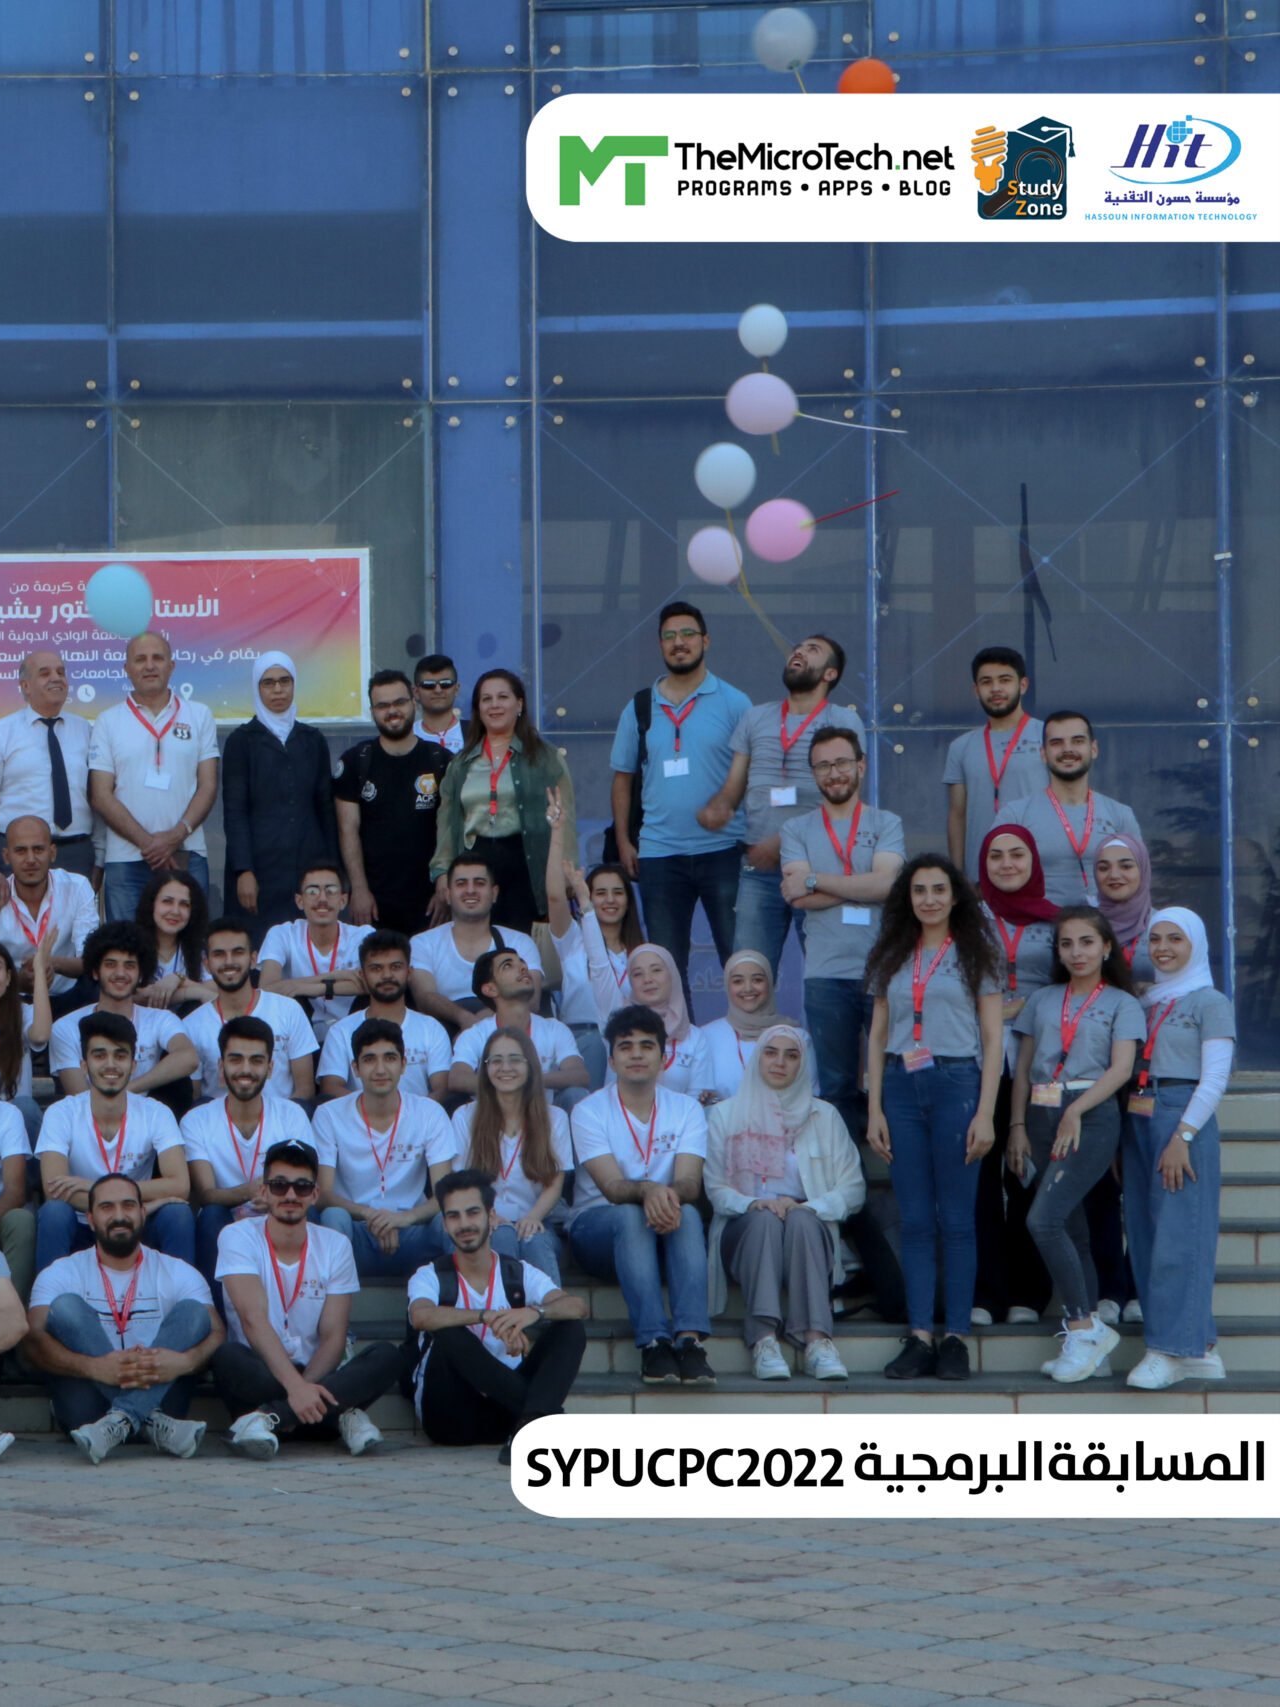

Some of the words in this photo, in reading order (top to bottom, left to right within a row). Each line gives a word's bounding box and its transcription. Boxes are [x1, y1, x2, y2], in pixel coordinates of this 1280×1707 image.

[9, 582, 30, 595] من
[33, 581, 73, 595] كريمة
[151, 594, 219, 618] الأستا
[8, 630, 48, 644] الدولية
[52, 630, 88, 645] الوادي
[171, 648, 196, 664] رحا
[200, 648, 224, 666] في
